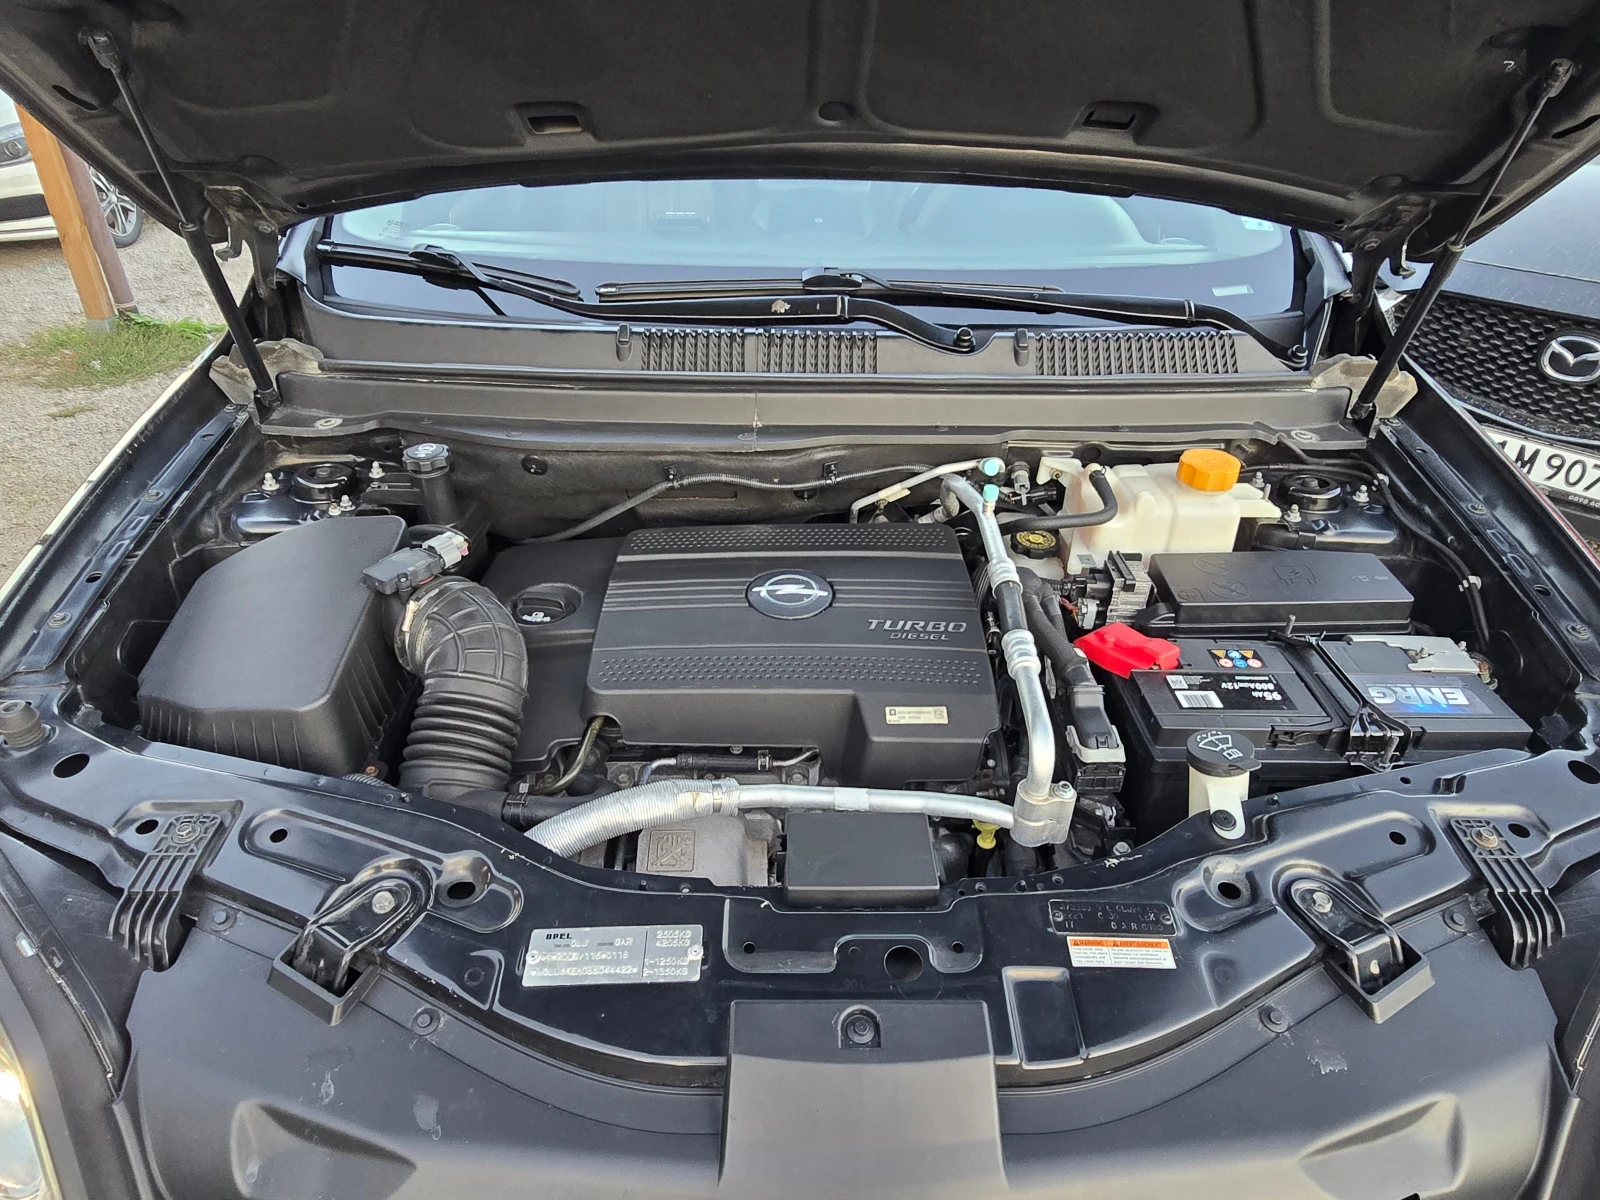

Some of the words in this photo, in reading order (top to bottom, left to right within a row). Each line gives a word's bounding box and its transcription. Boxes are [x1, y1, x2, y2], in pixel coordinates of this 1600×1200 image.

[868, 619, 967, 633] TURBO
[889, 632, 950, 641] DIESEL
[1367, 686, 1470, 705] ENRG
[546, 932, 572, 940] OPEL
